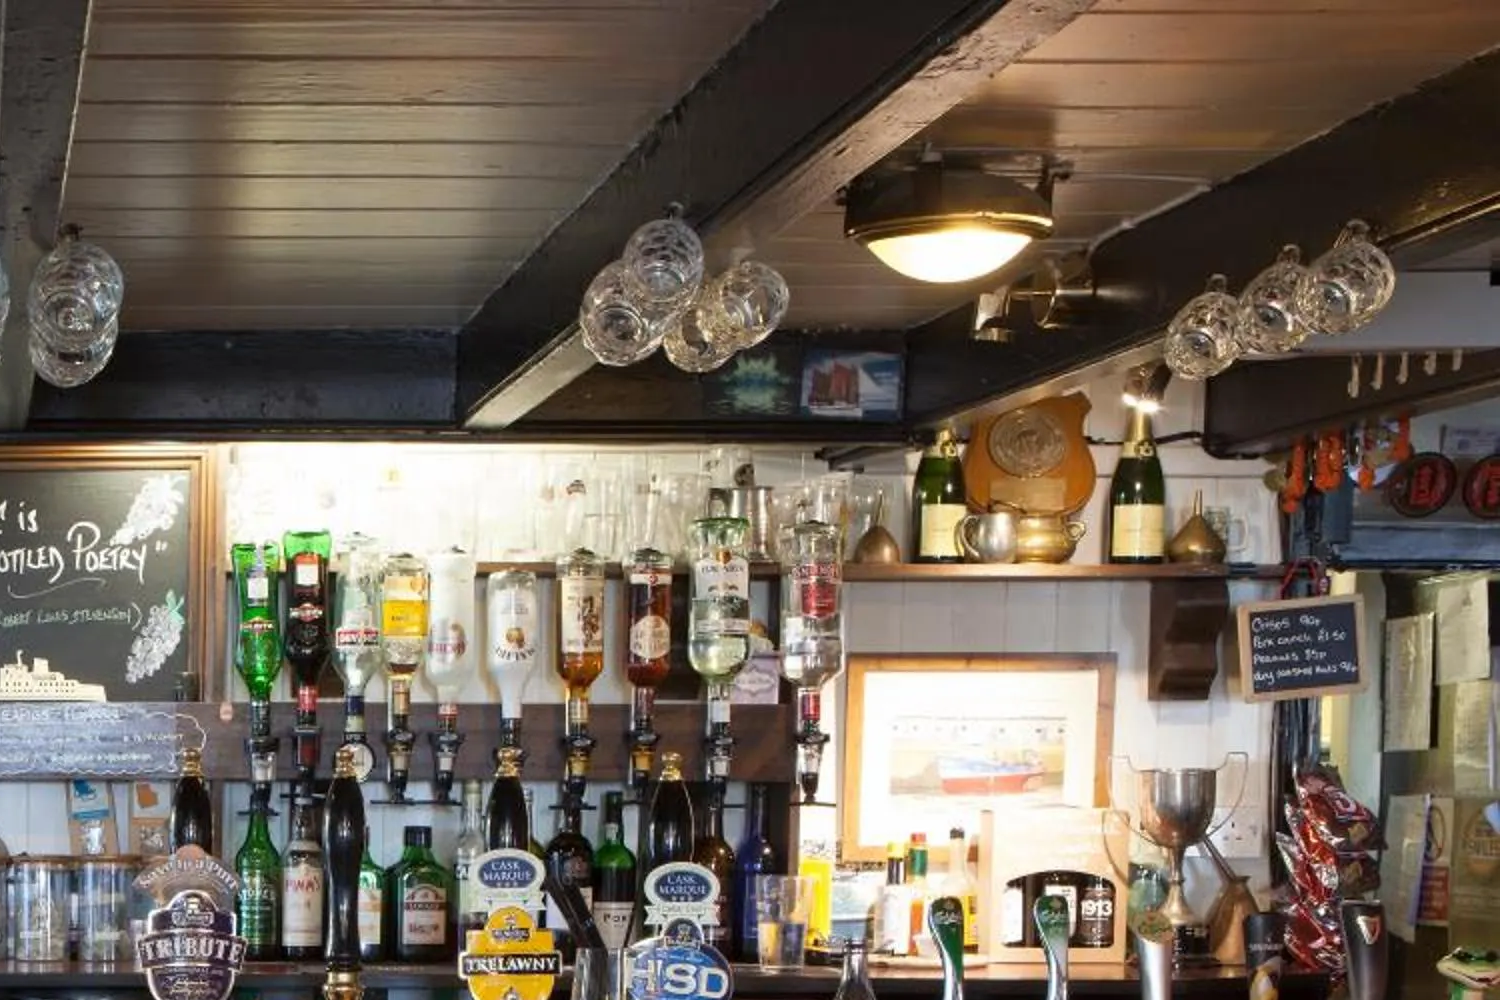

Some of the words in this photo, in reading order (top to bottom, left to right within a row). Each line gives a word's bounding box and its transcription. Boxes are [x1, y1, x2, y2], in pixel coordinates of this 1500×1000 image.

[490, 860, 521, 871] CASK
[482, 870, 533, 882] MARQUE
[666, 874, 698, 885] CASK
[659, 884, 707, 896] MARQUE
[1081, 900, 1113, 917] 1913
[141, 935, 244, 963] TRIBUTE
[464, 956, 557, 973] TRELAWNY
[625, 957, 730, 999] HSD
